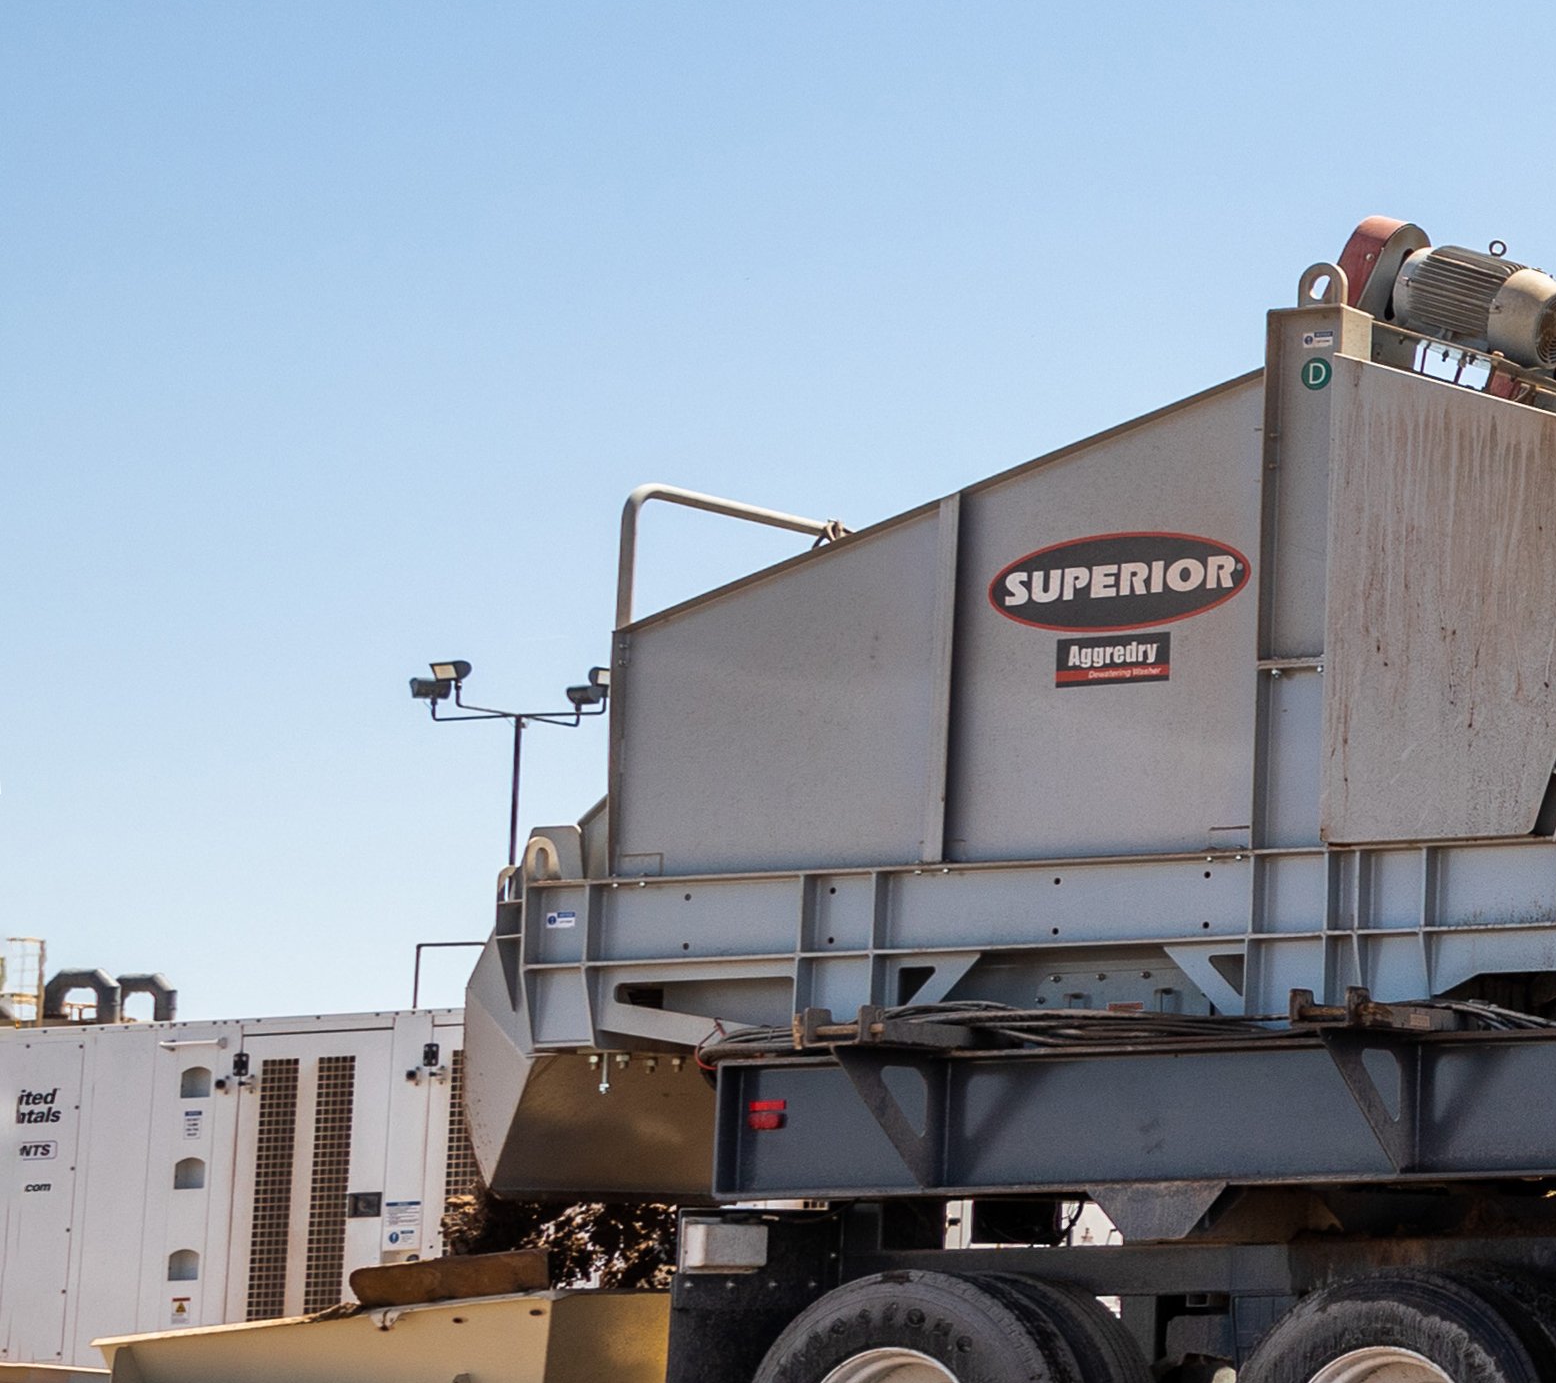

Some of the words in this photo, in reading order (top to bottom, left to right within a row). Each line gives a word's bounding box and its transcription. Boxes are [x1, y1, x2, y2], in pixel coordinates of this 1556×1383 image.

[1309, 362, 1326, 384] D
[1004, 554, 1237, 606] SUPERIOR
[1068, 641, 1158, 668] Aggredry
[1088, 669, 1131, 679] Dewatering
[1132, 667, 1162, 677] Washer
[19, 1087, 58, 1106] ited
